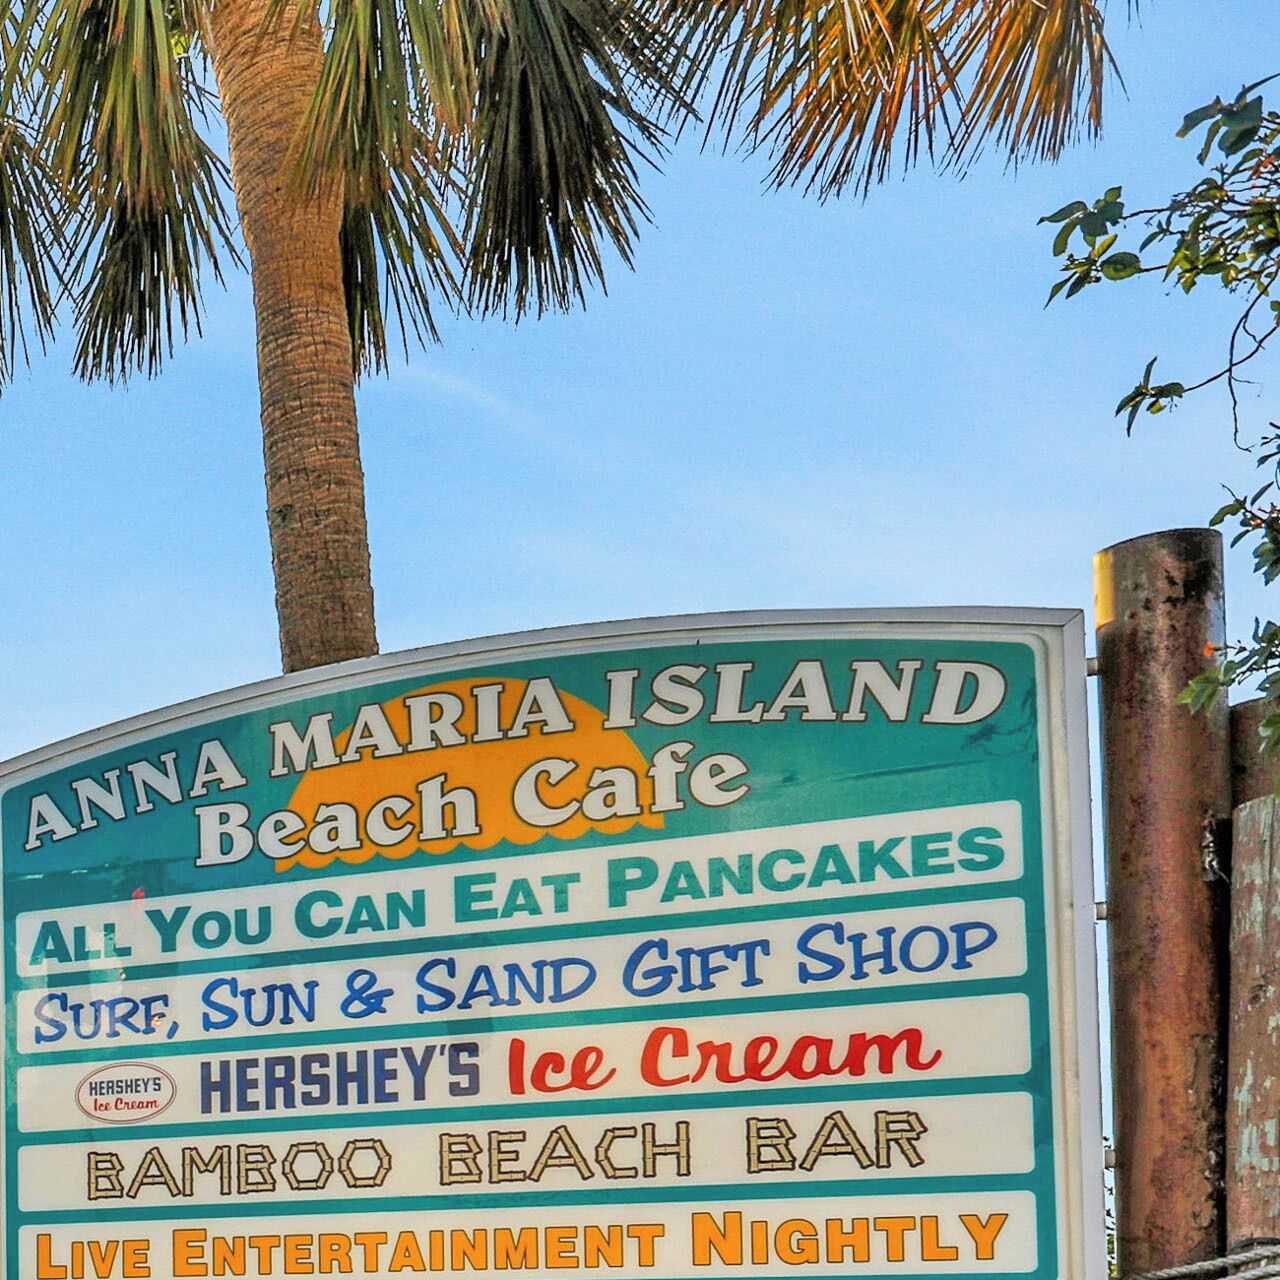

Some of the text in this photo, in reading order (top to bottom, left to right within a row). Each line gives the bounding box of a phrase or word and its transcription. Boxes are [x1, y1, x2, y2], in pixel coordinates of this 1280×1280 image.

[24, 658, 1008, 852] ANNA MARIA ISLAND
[194, 740, 751, 868] Beach Cafe
[29, 826, 1005, 966] ALL YOU CAN EAT PANCAKES
[201, 977, 320, 1033] SUN
[340, 968, 394, 1019] &
[416, 956, 597, 1015] SAND
[622, 938, 770, 998] GIFT
[797, 921, 999, 984] SHOP
[89, 1077, 162, 1097] HERSHEY'S
[94, 1097, 160, 1112] Ice Cream
[200, 1026, 942, 1114] HERSHEY'S Ice Cream
[86, 1110, 928, 1200] BAMBOO BEACH BAR
[35, 1211, 1009, 1280] LIVE ENTERTAINMENT NIGHTLY
